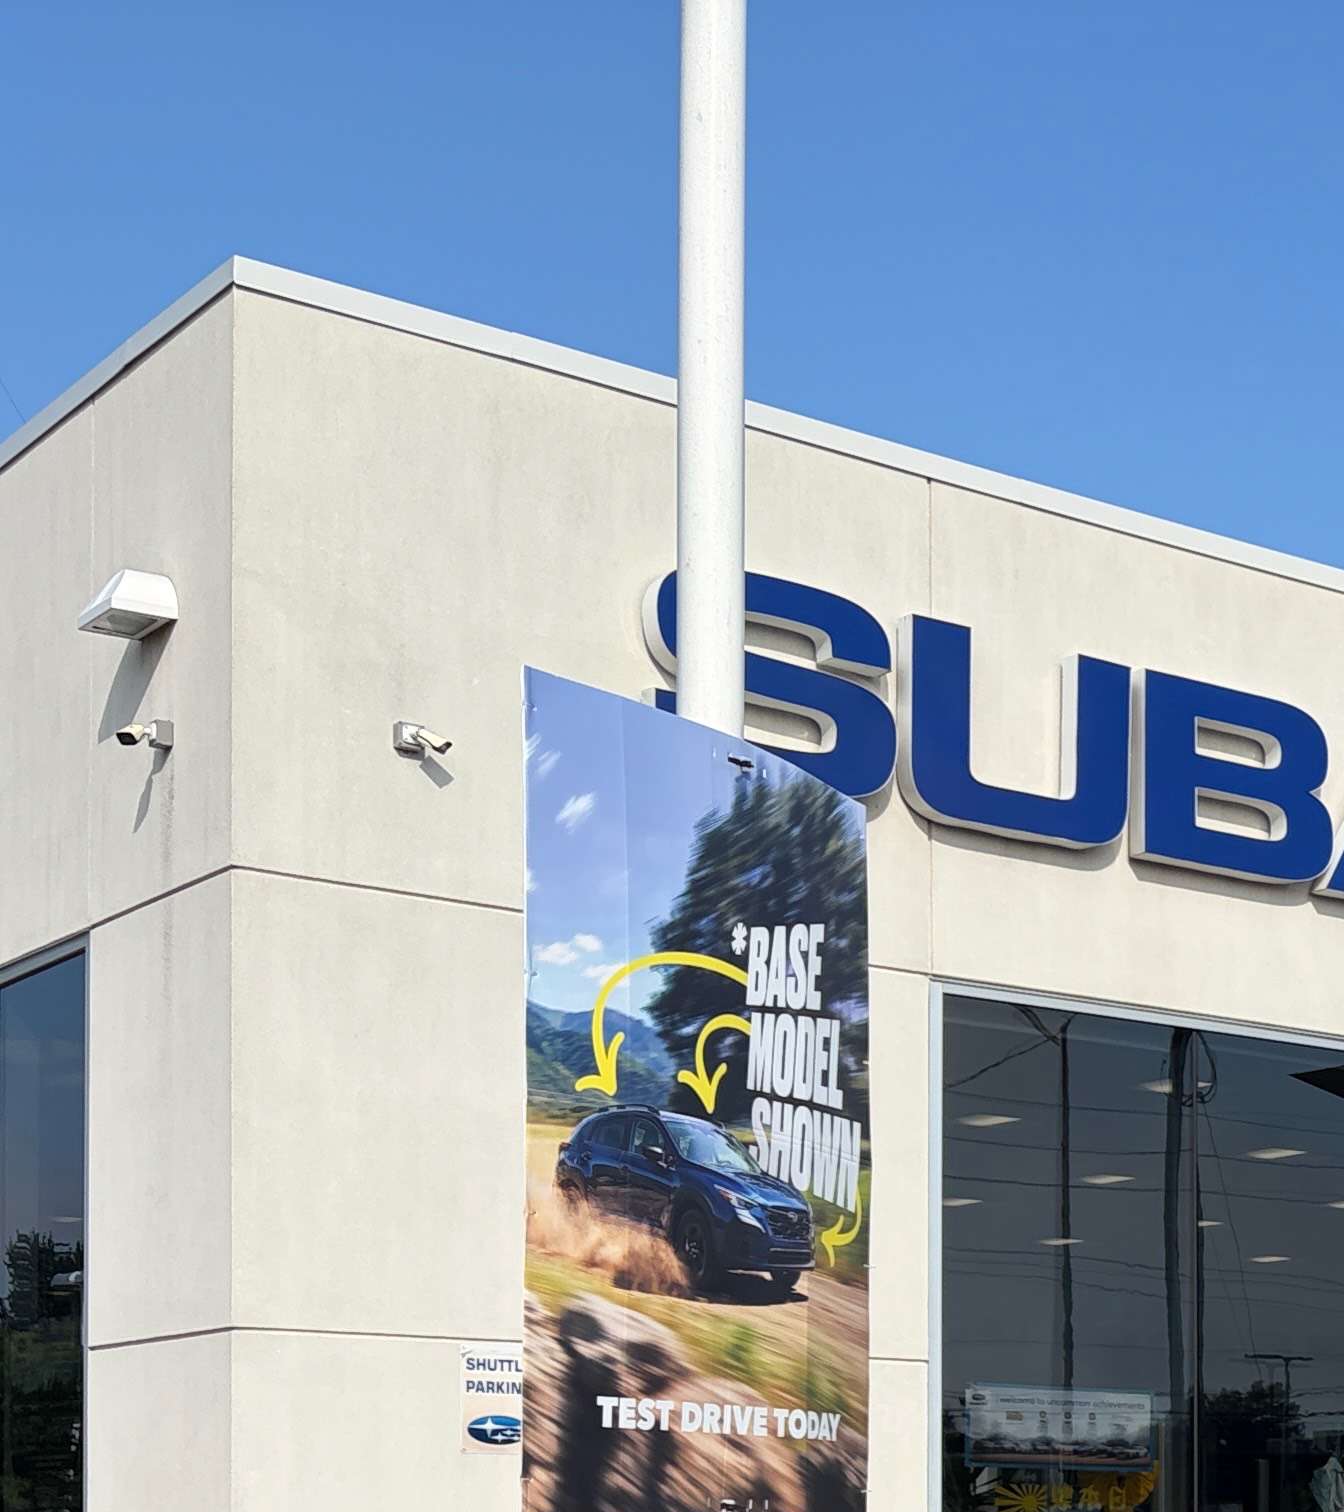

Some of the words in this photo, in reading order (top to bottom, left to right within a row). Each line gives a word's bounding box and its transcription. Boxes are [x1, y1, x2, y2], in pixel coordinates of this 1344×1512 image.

[746, 1012, 844, 1110] MODEL
[749, 1097, 862, 1213] SHOWN
[465, 1357, 523, 1373] SHUTTL
[465, 1380, 522, 1395] PARKIN
[596, 1395, 675, 1431] TEST
[680, 1401, 768, 1437] DRIVE
[772, 1408, 841, 1442] TODAY
